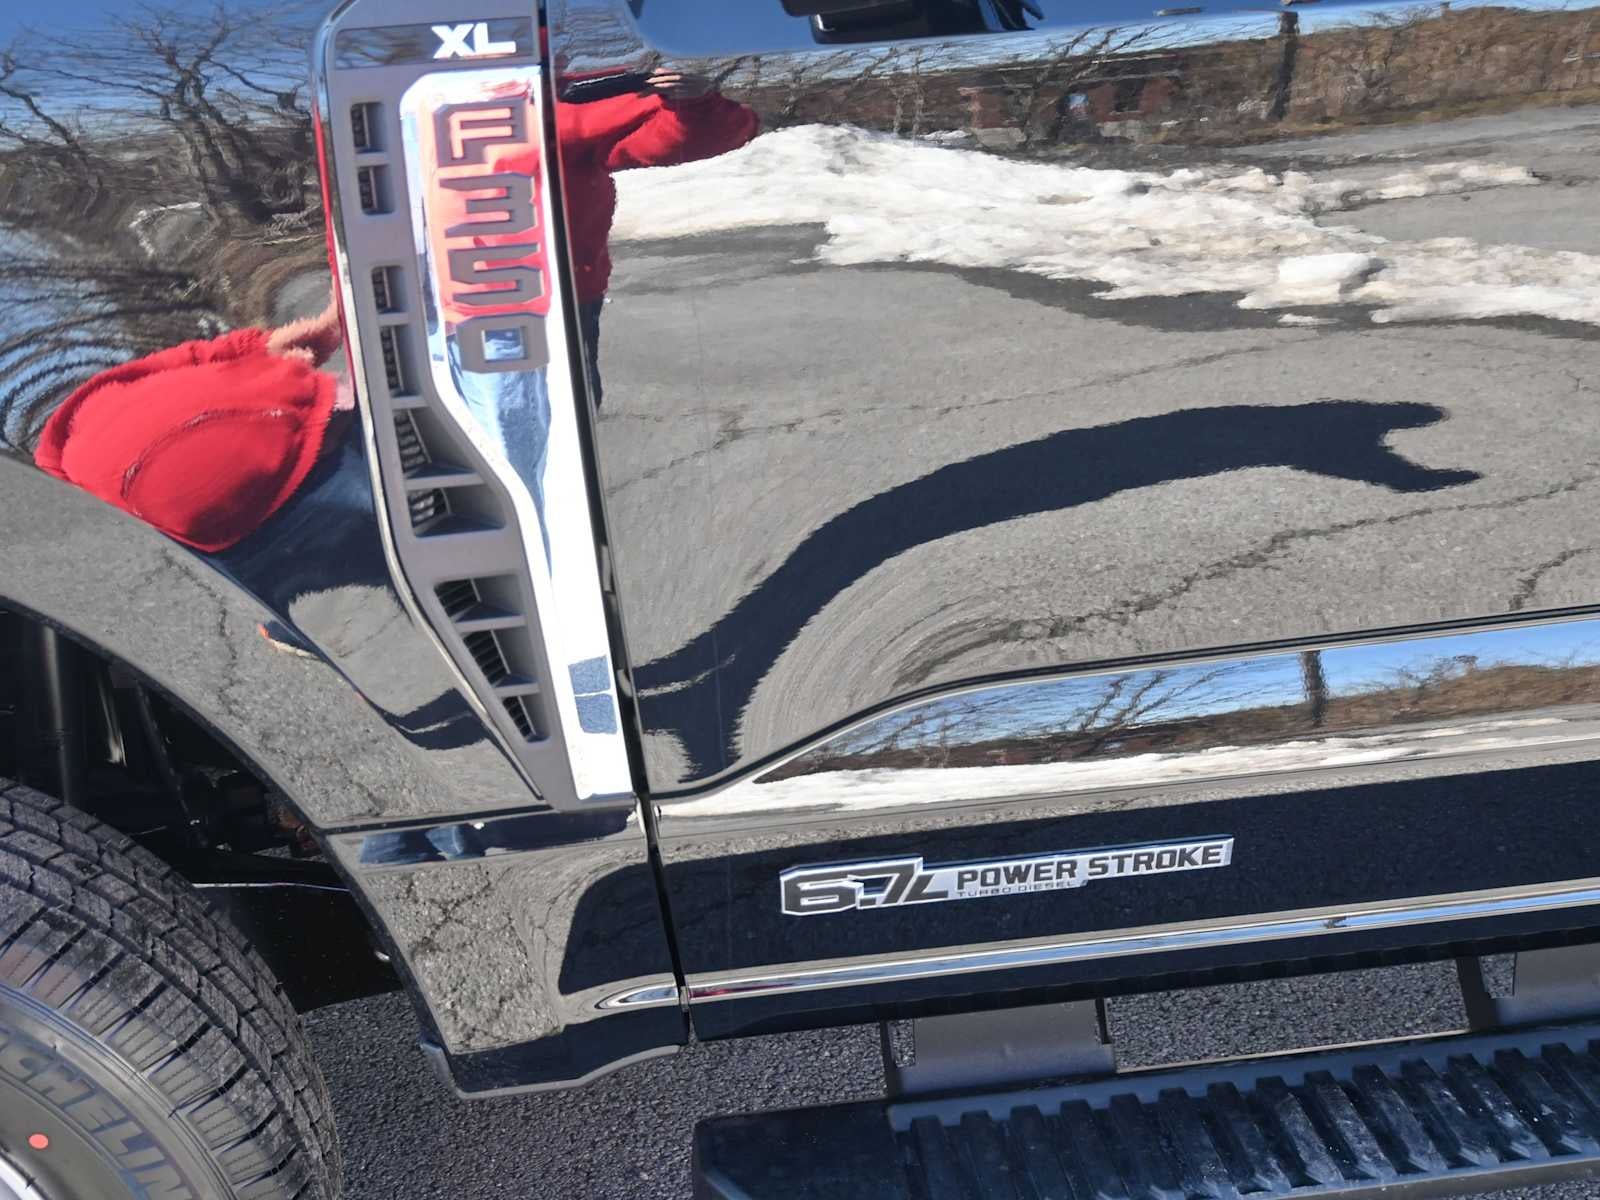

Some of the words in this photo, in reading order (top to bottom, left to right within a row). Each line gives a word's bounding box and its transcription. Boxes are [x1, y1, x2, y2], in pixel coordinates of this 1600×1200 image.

[431, 22, 517, 60] XL
[433, 97, 551, 374] F350
[782, 861, 949, 914] 6.7L
[957, 859, 1078, 891] POWER
[1087, 842, 1223, 876] STROKE
[956, 886, 1012, 898] TURBO
[1017, 881, 1076, 893] DIESEL
[0, 1030, 193, 1199] CHELIN
